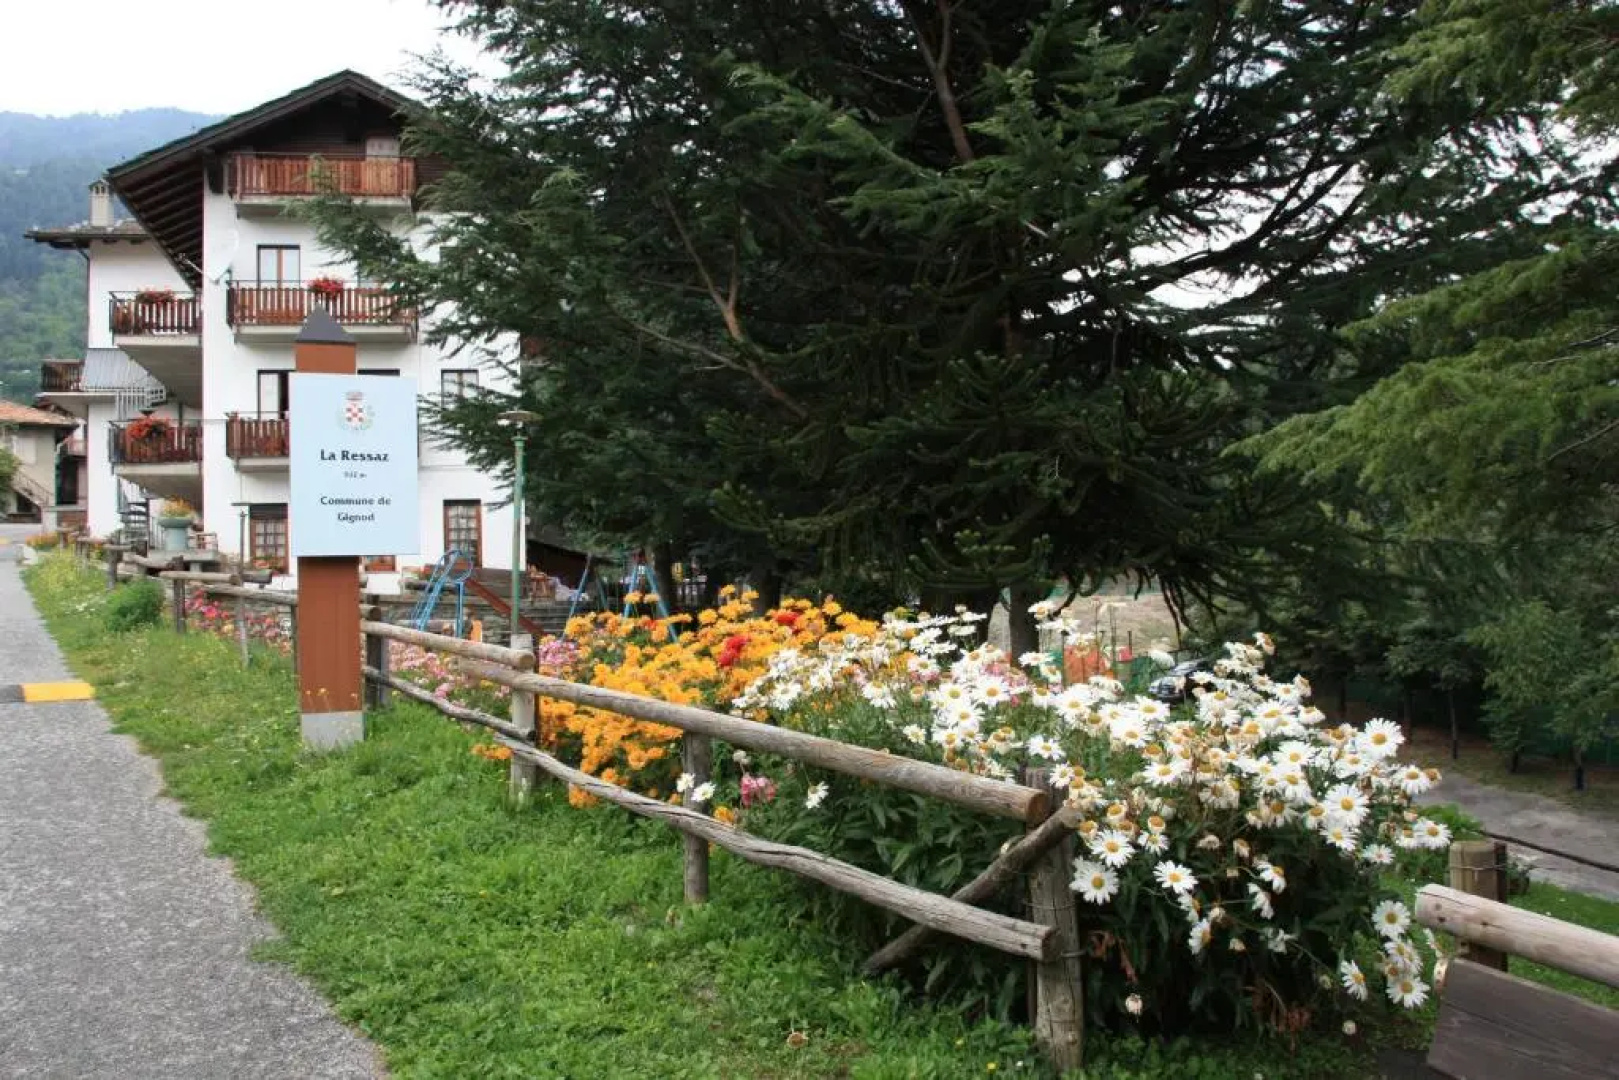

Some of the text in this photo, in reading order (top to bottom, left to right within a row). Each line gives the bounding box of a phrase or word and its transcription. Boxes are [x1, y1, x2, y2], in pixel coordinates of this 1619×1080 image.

[320, 448, 389, 462] La Ressaz
[320, 496, 392, 505] Commune de
[337, 512, 375, 523] Gignod
